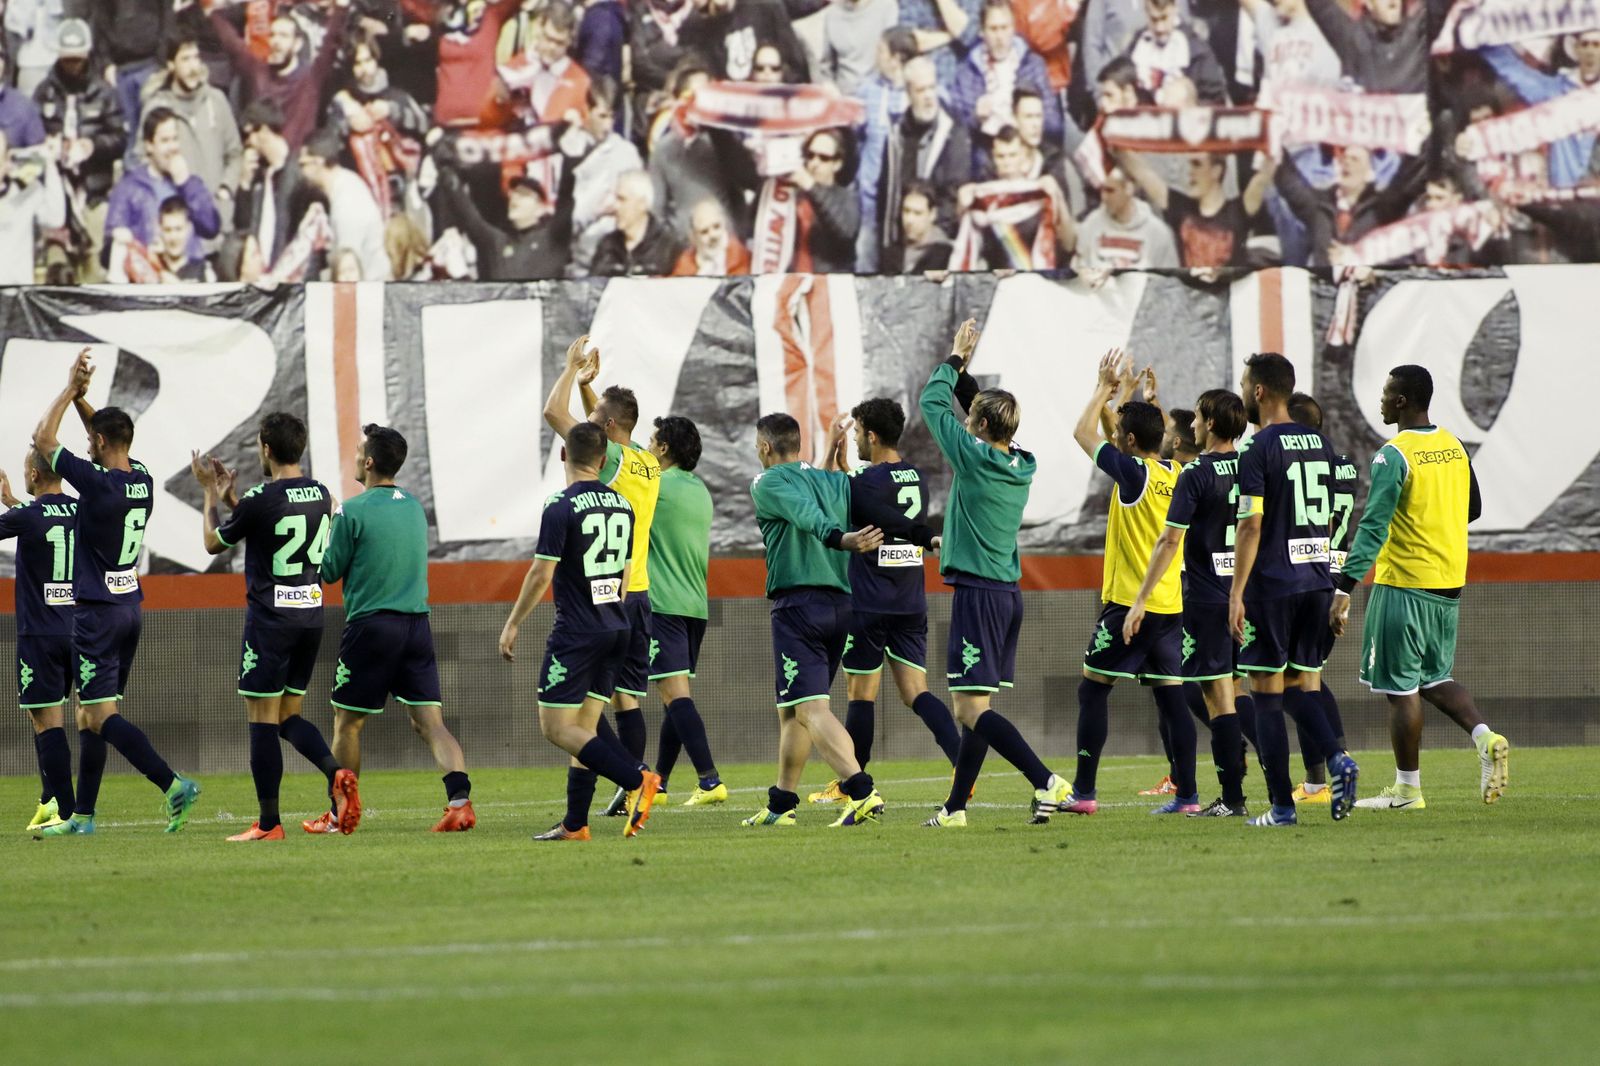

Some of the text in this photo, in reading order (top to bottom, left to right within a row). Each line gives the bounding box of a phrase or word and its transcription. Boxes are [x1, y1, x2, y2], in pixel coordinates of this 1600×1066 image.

[1279, 433, 1323, 450] DEIVID
[1413, 448, 1463, 466] Kappa
[889, 468, 920, 483] CARO
[1212, 458, 1239, 476] BITT
[124, 482, 149, 499] LUSO
[285, 485, 323, 503] AGUZA
[1286, 461, 1331, 527] 15
[569, 491, 601, 513] JAVI
[117, 507, 147, 566] 6
[272, 513, 330, 577] 24
[581, 512, 631, 577] 29
